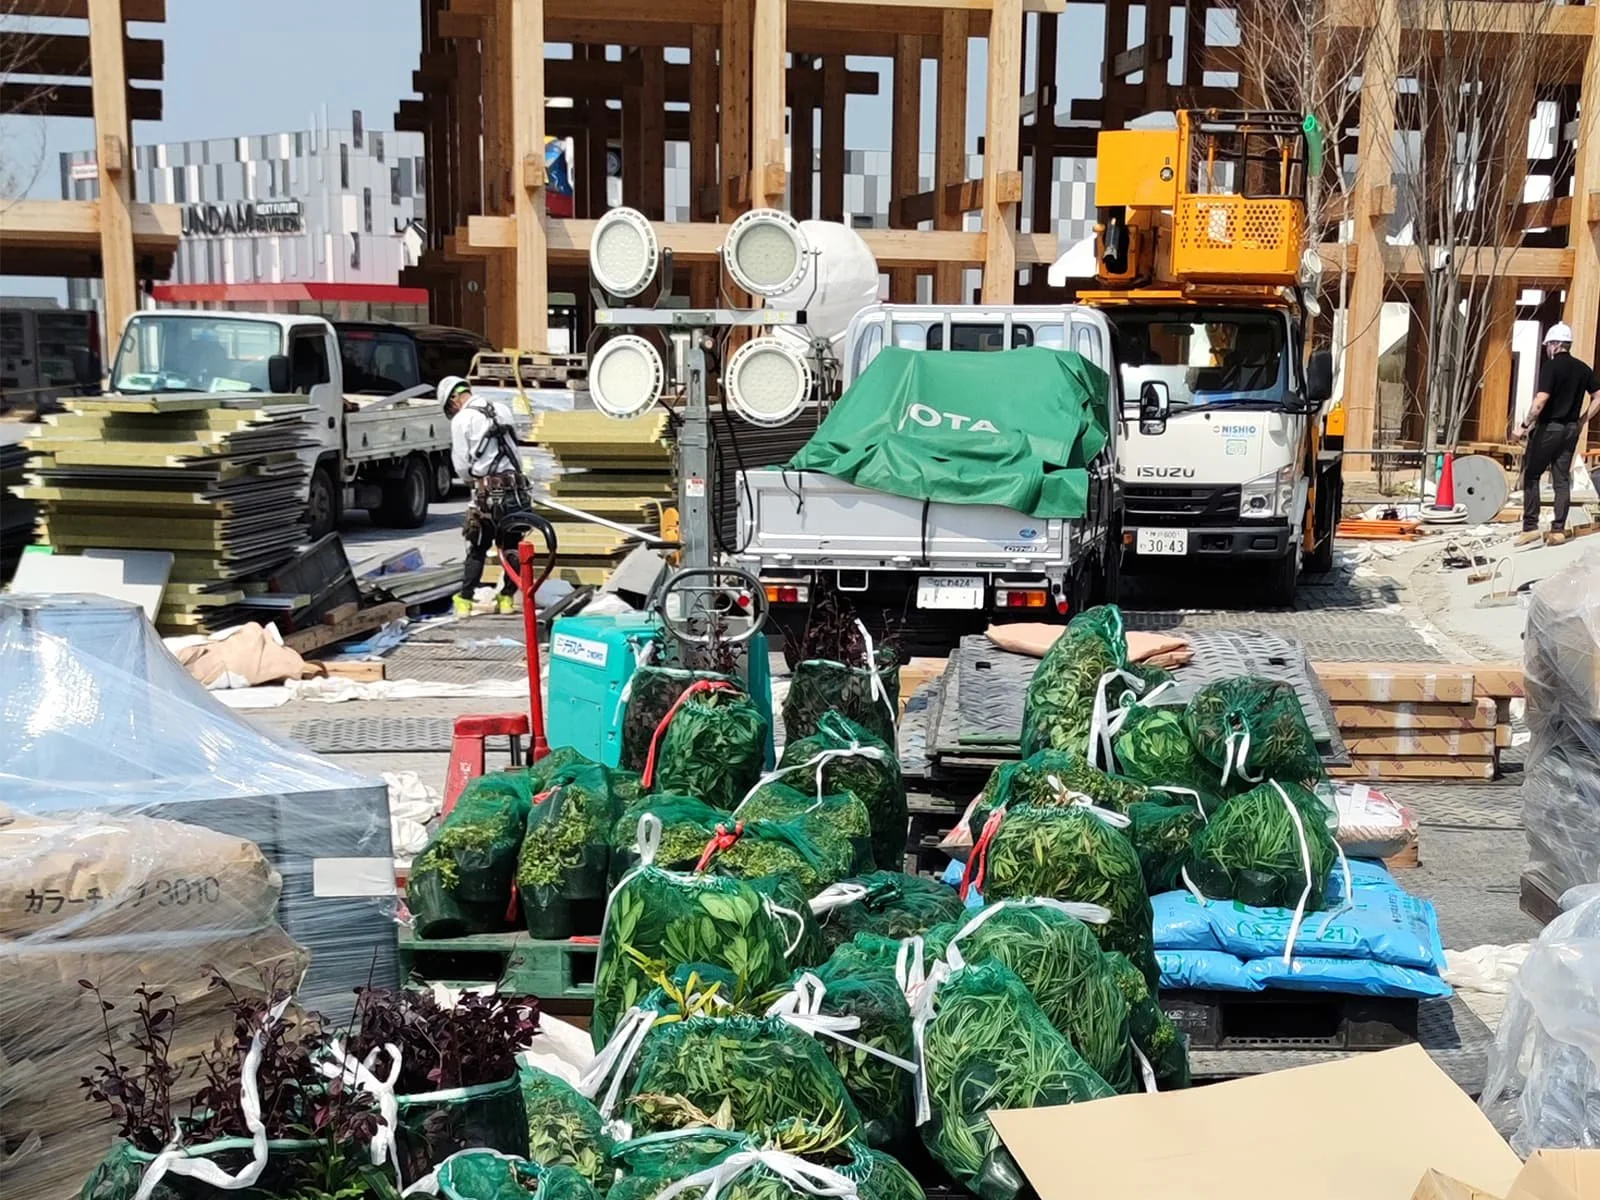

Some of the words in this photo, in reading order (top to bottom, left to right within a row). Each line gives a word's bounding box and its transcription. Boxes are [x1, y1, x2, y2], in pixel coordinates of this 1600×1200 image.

[1221, 425, 1256, 434] NISHIO
[1137, 467, 1195, 478] ISUZU
[1149, 540, 1184, 553] 30-43
[155, 876, 220, 907] 3010
